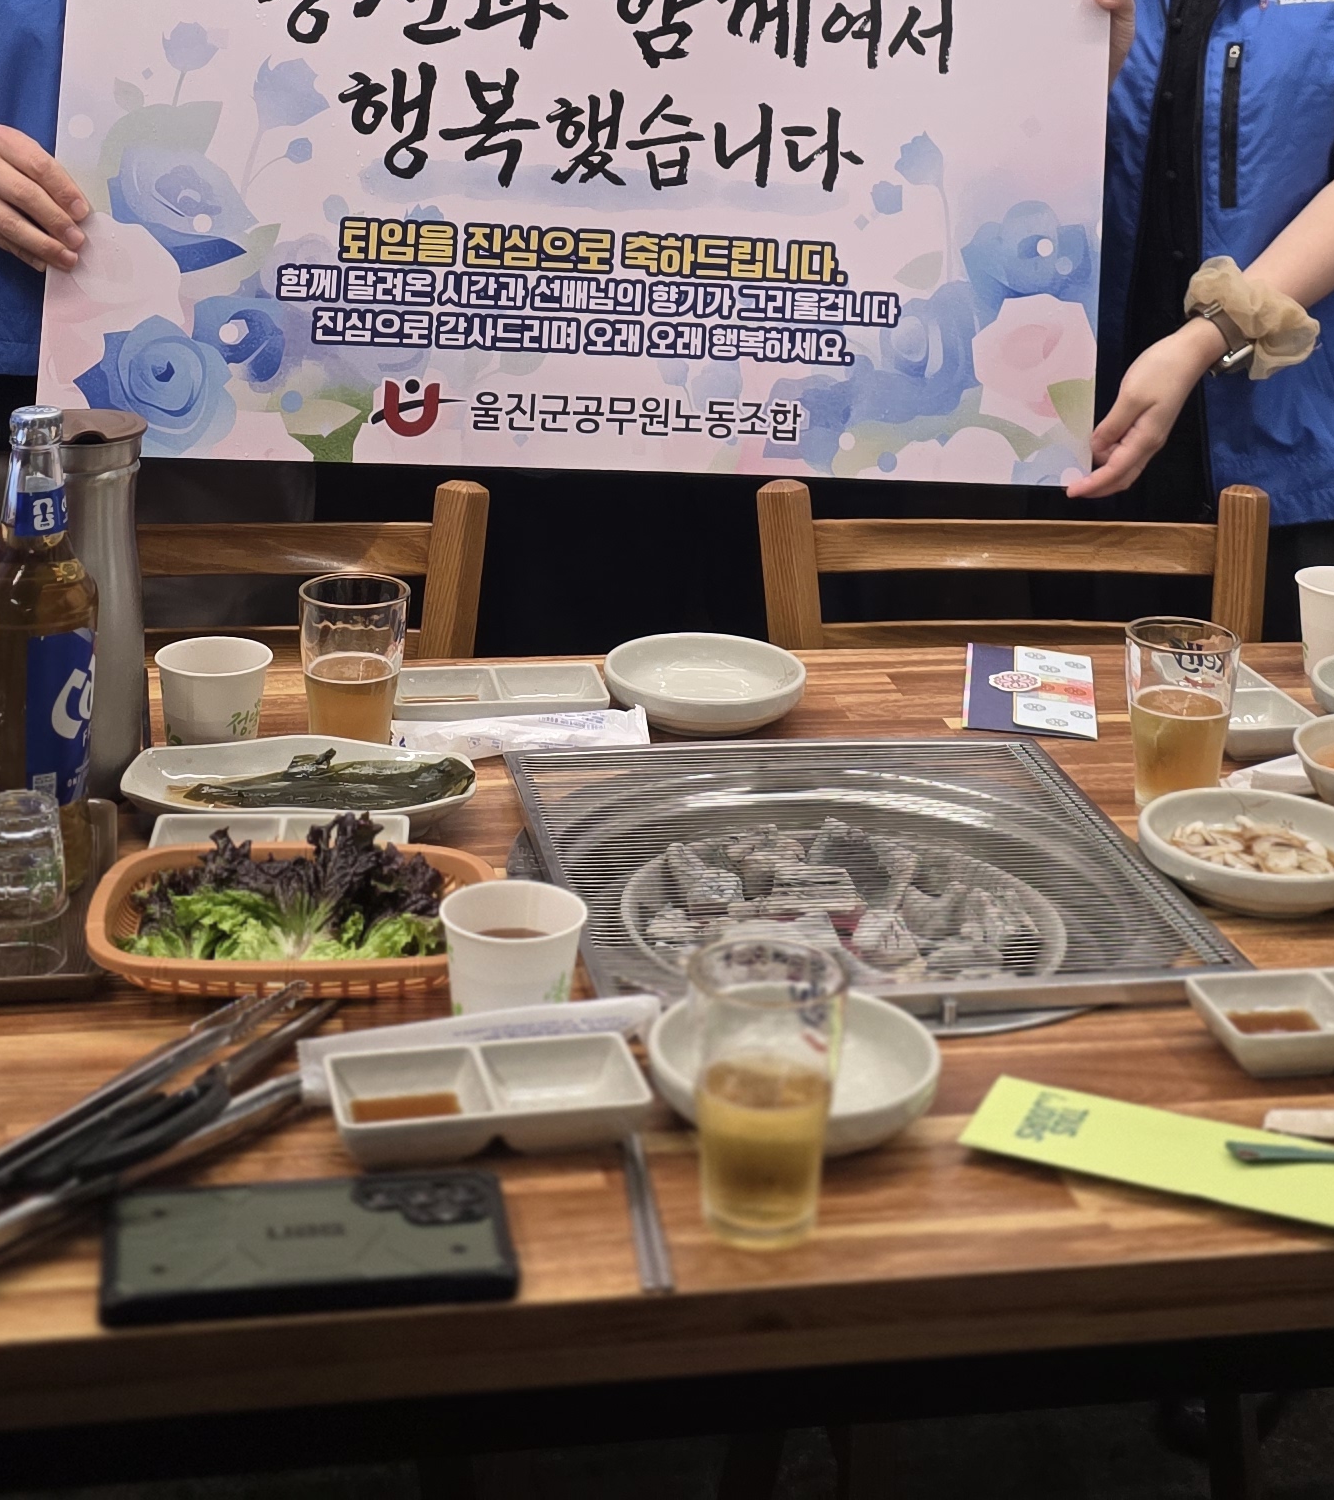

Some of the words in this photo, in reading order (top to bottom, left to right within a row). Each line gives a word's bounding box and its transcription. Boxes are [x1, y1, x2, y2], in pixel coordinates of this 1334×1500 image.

[339, 64, 864, 192] 행복했습니다
[339, 216, 458, 267] 퇴임을
[464, 222, 615, 273] 진심으로
[621, 231, 848, 284] 축하드립니다.
[277, 265, 340, 301] 함께
[343, 267, 436, 305] 달려온
[438, 270, 529, 310] 시간과
[531, 274, 645, 314] 선배님의
[648, 281, 735, 318] 향기가
[738, 286, 900, 327] 그리울겁니다
[312, 307, 432, 348] 진심으로
[435, 312, 580, 354] 감사드리며
[583, 318, 645, 356] 오래
[646, 321, 705, 358] 오래
[709, 324, 855, 366] 행복하세요.
[471, 392, 801, 441] 울진군공무원노동조합
